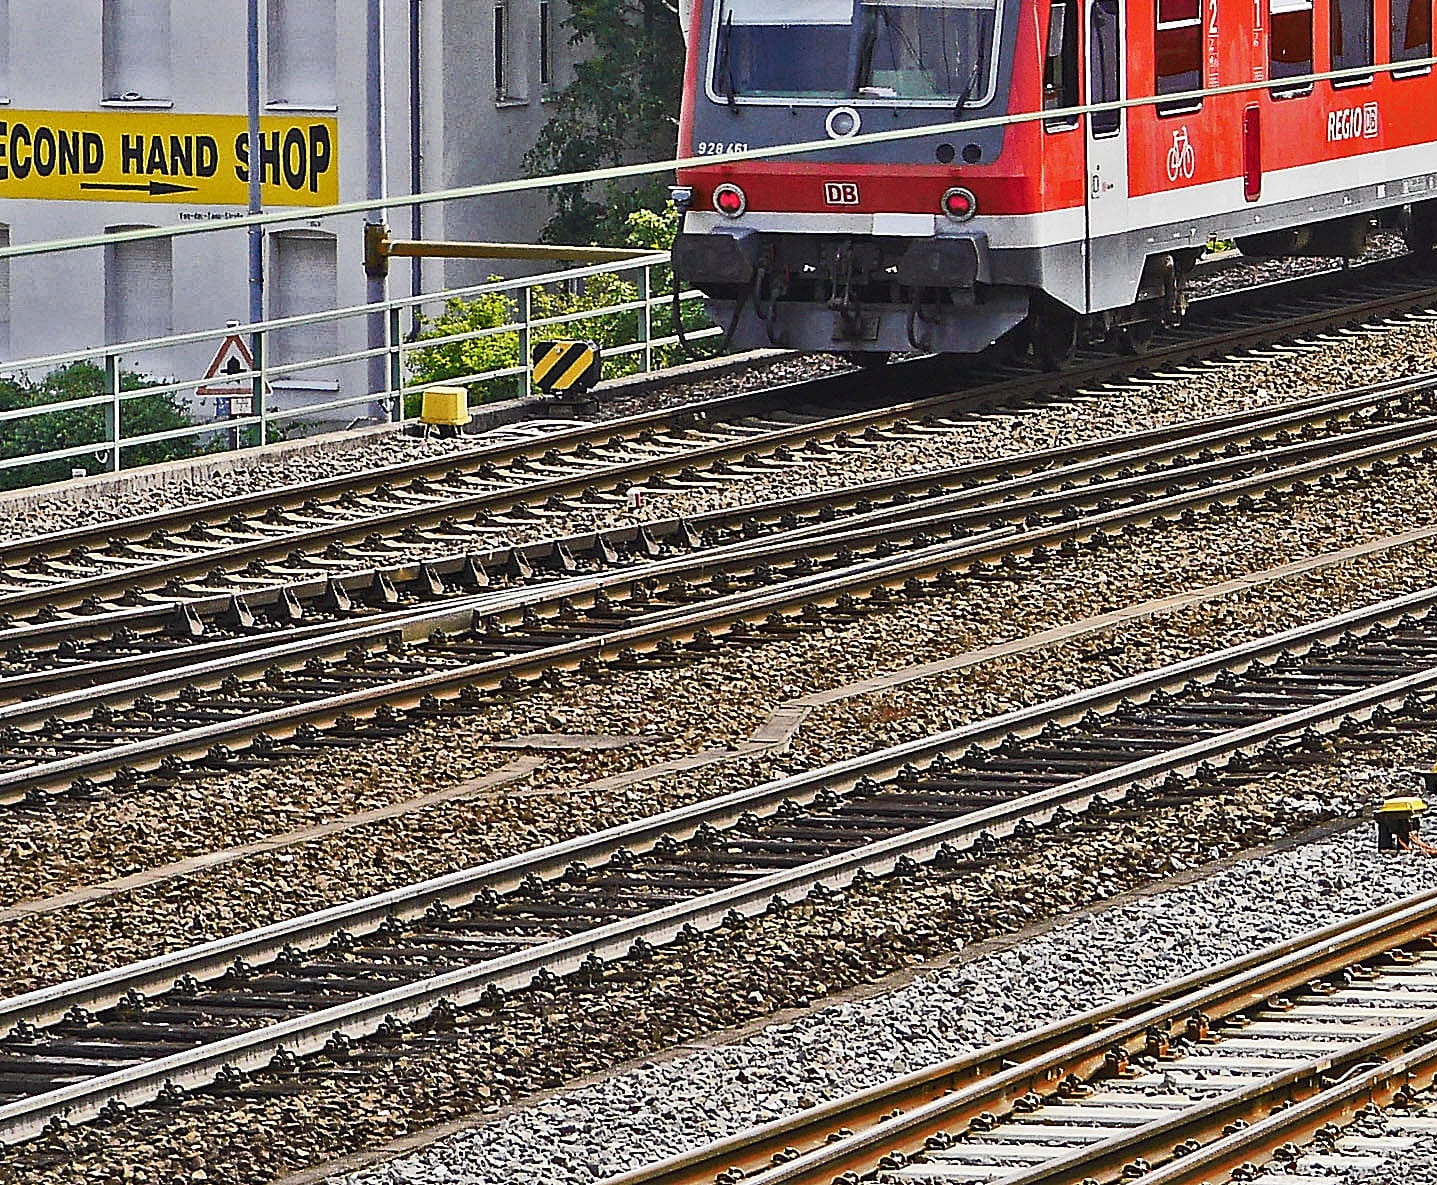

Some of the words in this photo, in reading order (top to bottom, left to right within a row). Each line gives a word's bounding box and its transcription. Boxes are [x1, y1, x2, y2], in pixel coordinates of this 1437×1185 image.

[1328, 107, 1362, 142] REGIO
[121, 134, 219, 177] HAND
[234, 124, 332, 193] SHOP
[698, 142, 723, 154] 928
[827, 184, 857, 203] DB
